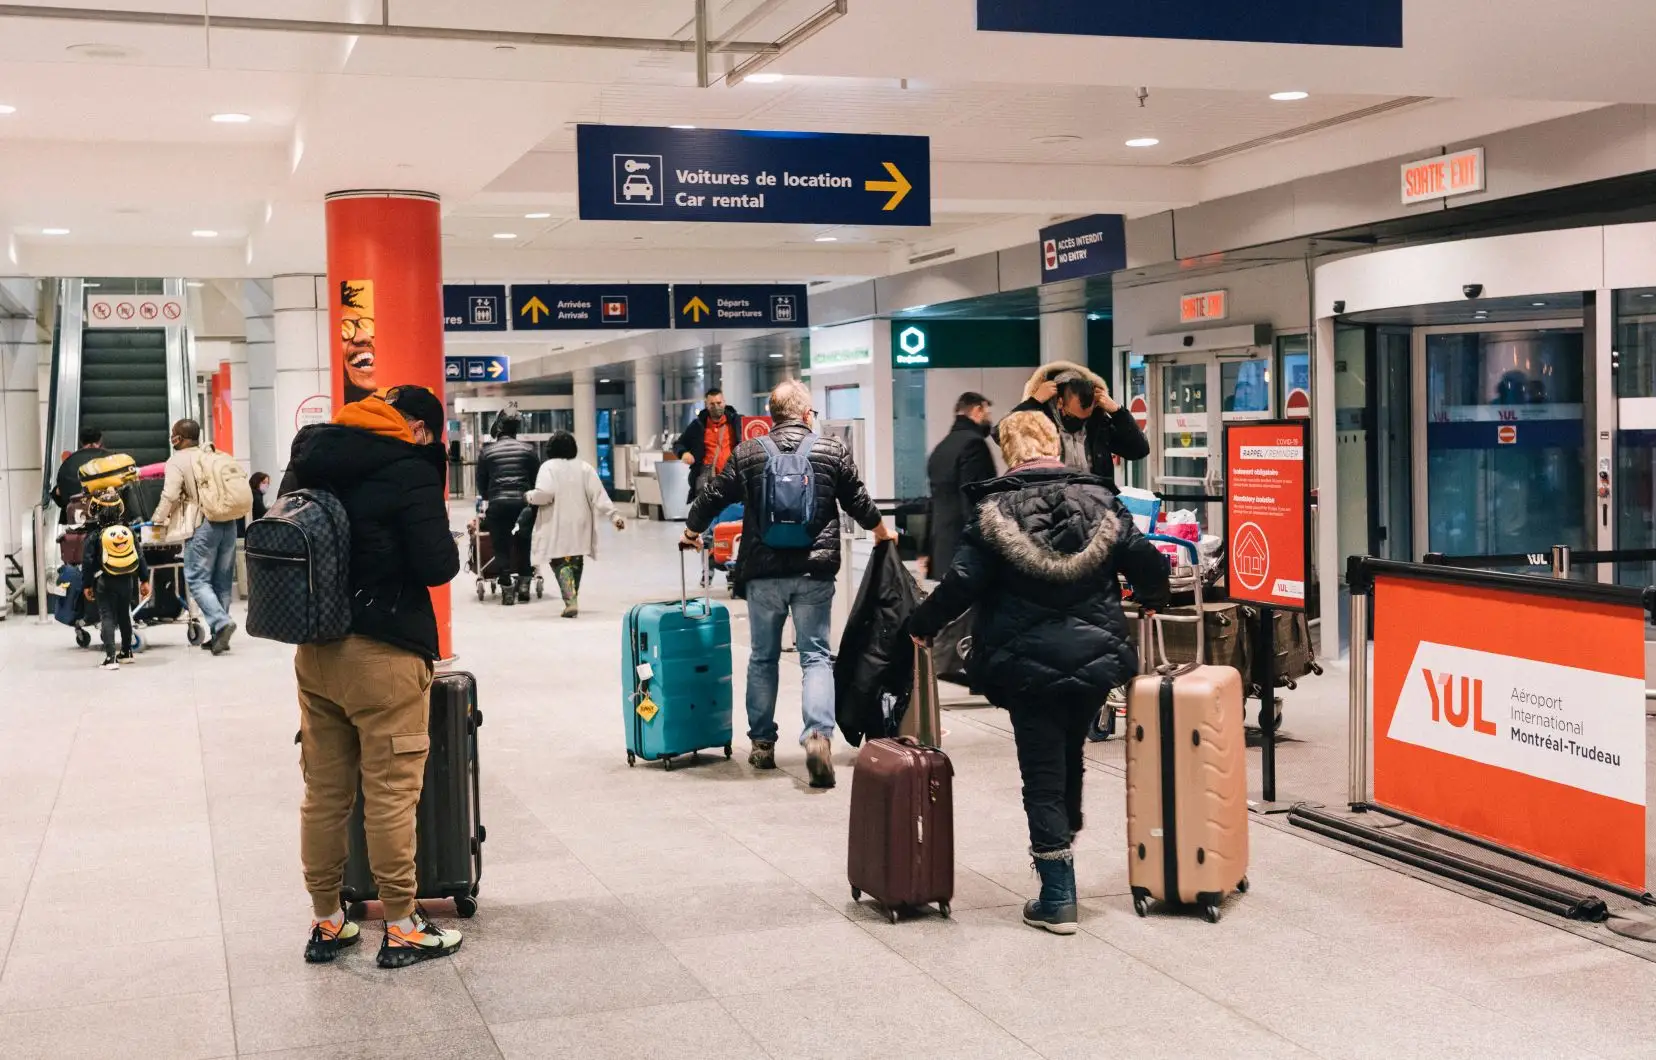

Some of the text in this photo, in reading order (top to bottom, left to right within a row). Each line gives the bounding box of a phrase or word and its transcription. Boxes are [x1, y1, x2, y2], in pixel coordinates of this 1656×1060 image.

[676, 169, 852, 188] Voitures de location
[1405, 155, 1477, 197] SORTIE EXIT
[675, 192, 765, 208] Car rental
[1057, 231, 1103, 250] ACCÈS INTERDIT
[1059, 249, 1088, 264] NO ENTRY
[557, 299, 592, 309] Arrivées
[717, 298, 750, 309] Départs
[443, 315, 464, 326] res
[557, 310, 589, 320] Arrivals
[717, 309, 763, 319] Departures
[1526, 553, 1548, 565] YUL
[1422, 668, 1497, 736] YUL
[1510, 687, 1564, 711] Aéroport
[1510, 705, 1584, 736] International
[1511, 727, 1621, 767] Montréal-Trudeau
